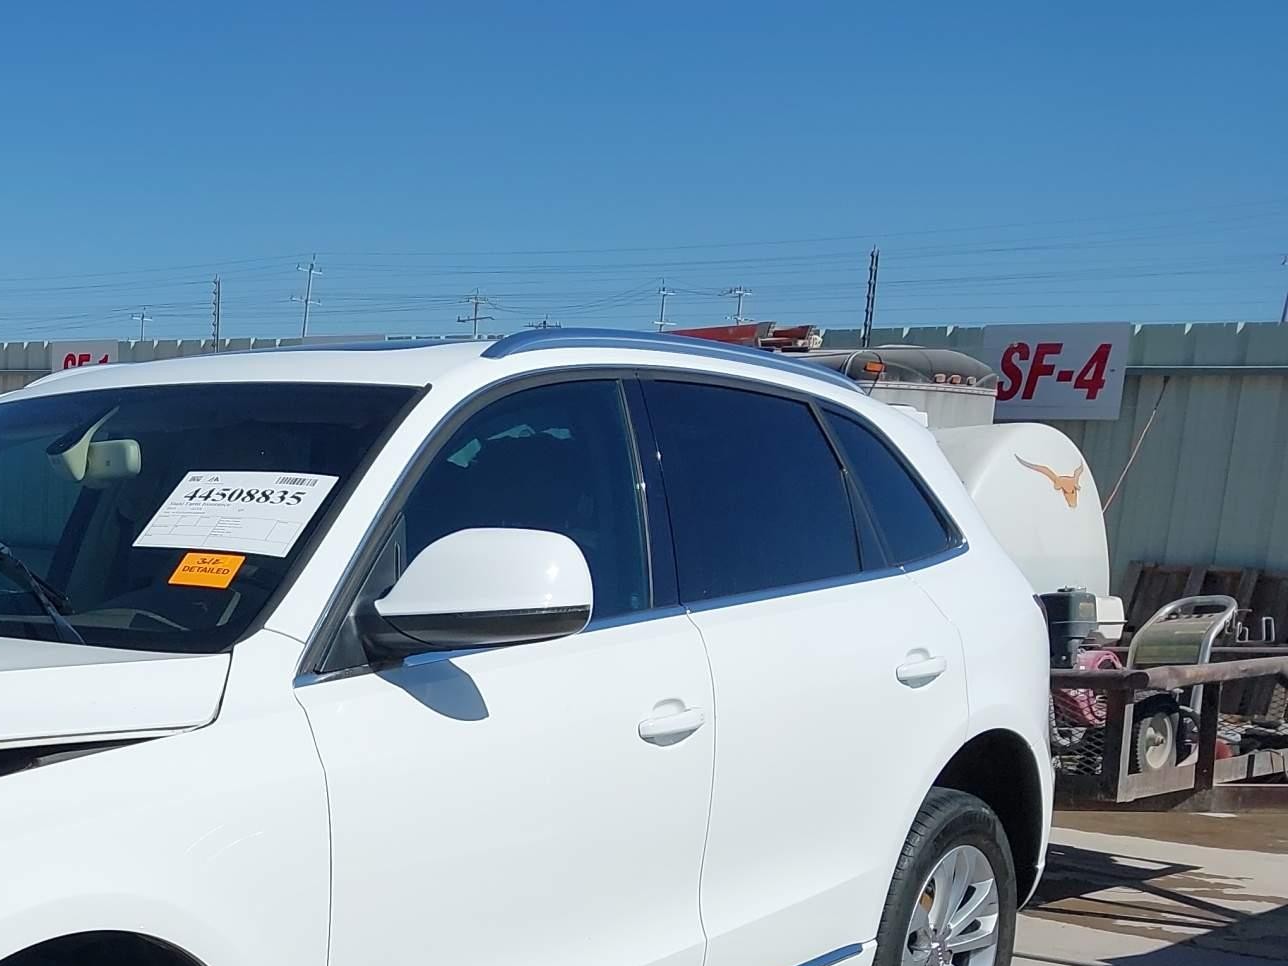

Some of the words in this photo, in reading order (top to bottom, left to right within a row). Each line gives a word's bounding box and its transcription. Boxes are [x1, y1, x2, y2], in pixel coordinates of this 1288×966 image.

[996, 342, 1112, 401] SF-4
[184, 487, 306, 506] 44508835
[182, 565, 230, 575] DETAILED
